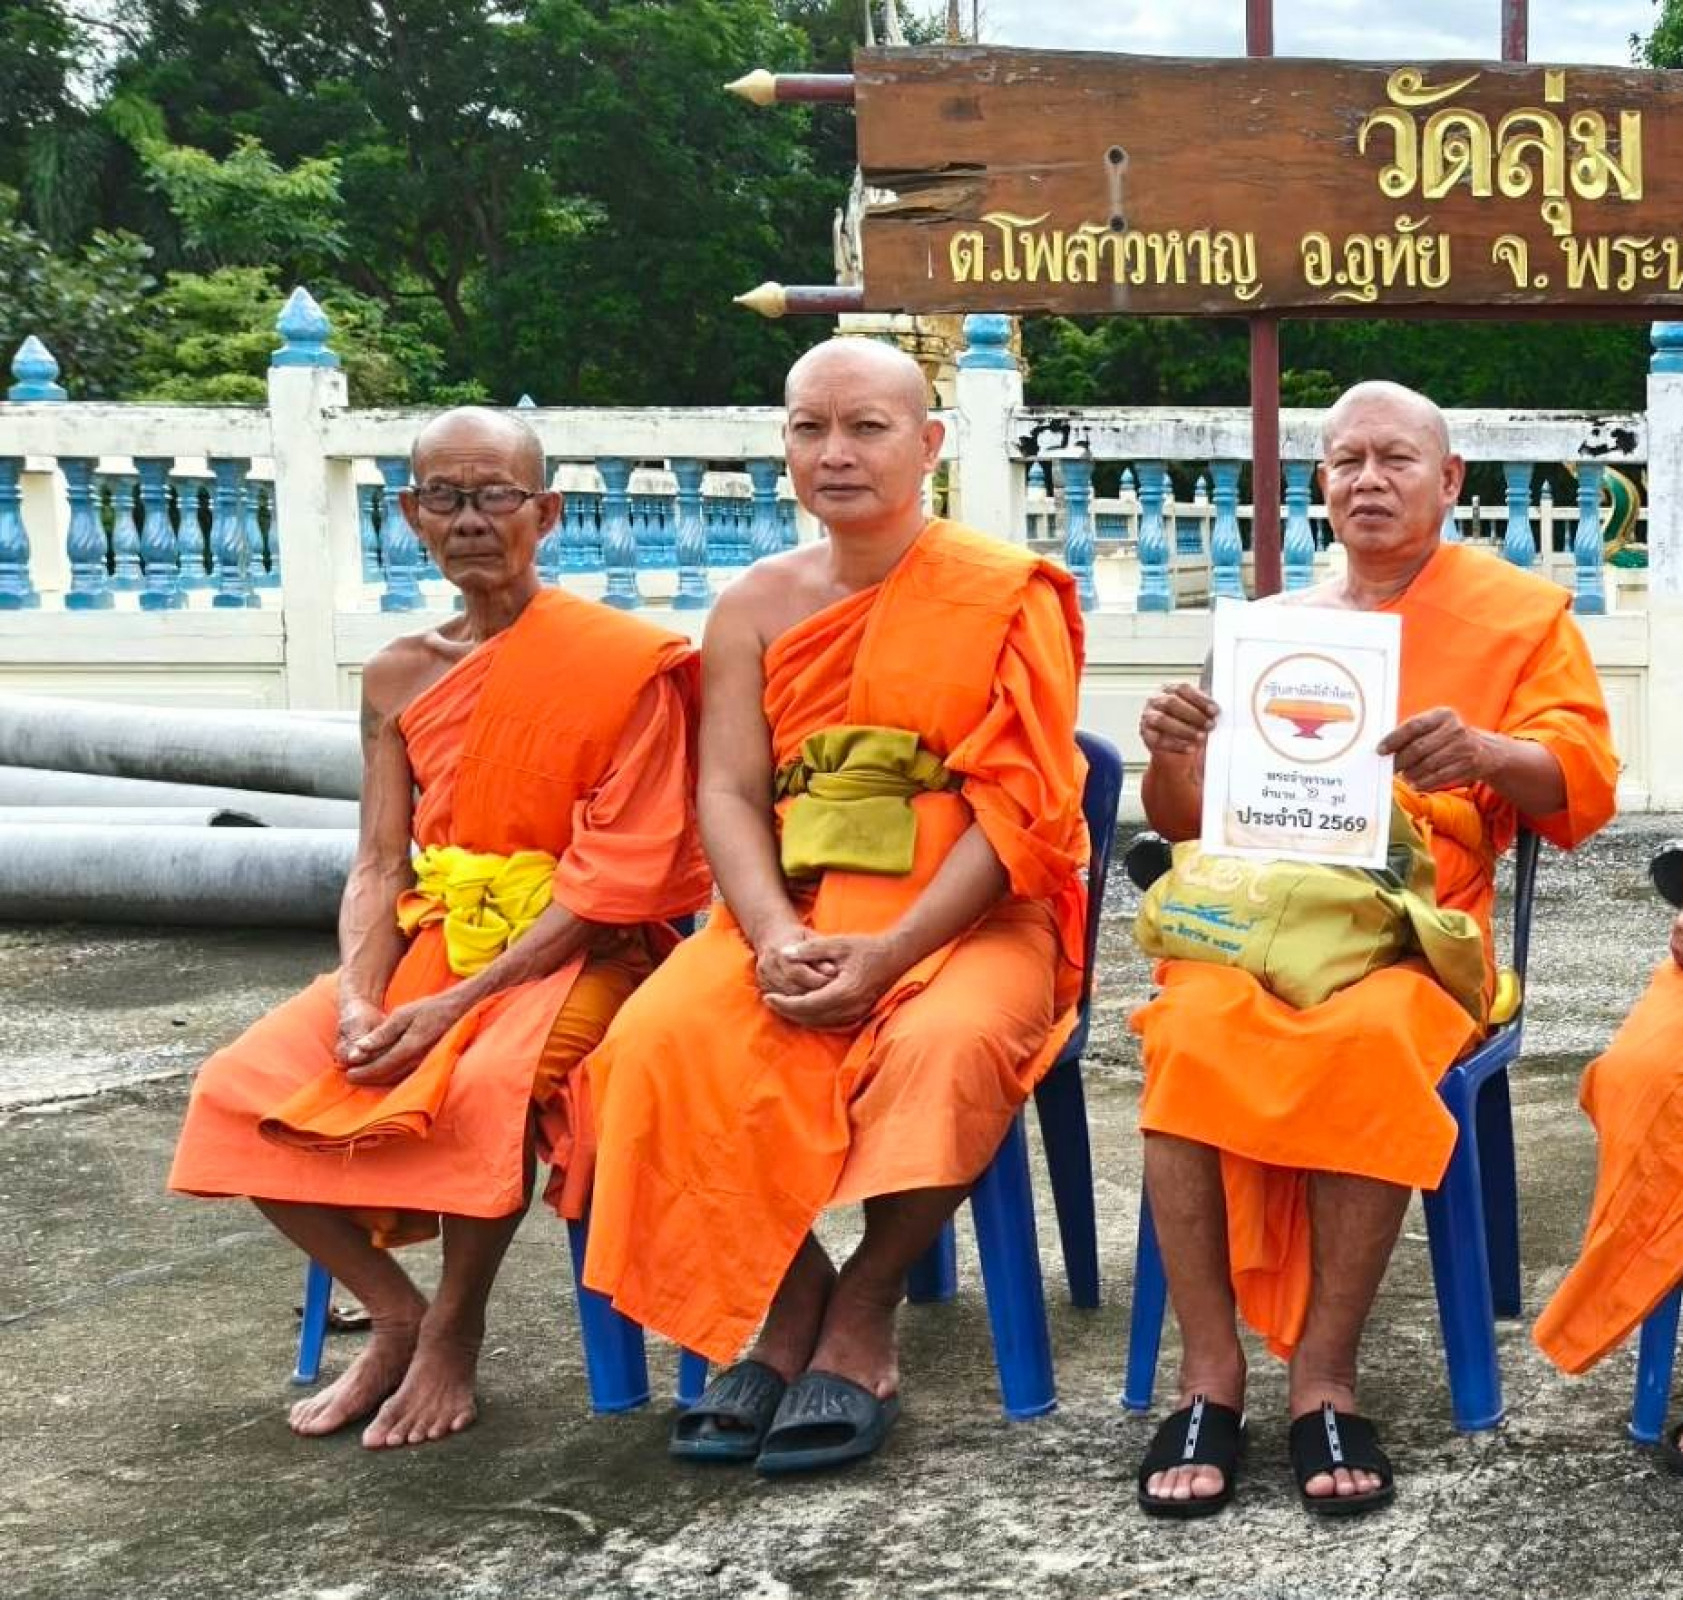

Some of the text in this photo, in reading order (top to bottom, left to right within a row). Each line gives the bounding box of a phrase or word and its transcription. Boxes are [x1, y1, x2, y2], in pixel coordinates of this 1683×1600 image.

[1358, 67, 1643, 236] วัดลุ่ม
[949, 212, 1263, 300] ต.โพสาวหาญ
[1301, 215, 1452, 301] อ.อุทัย
[1238, 806, 1367, 832] ประจำปี 2569
